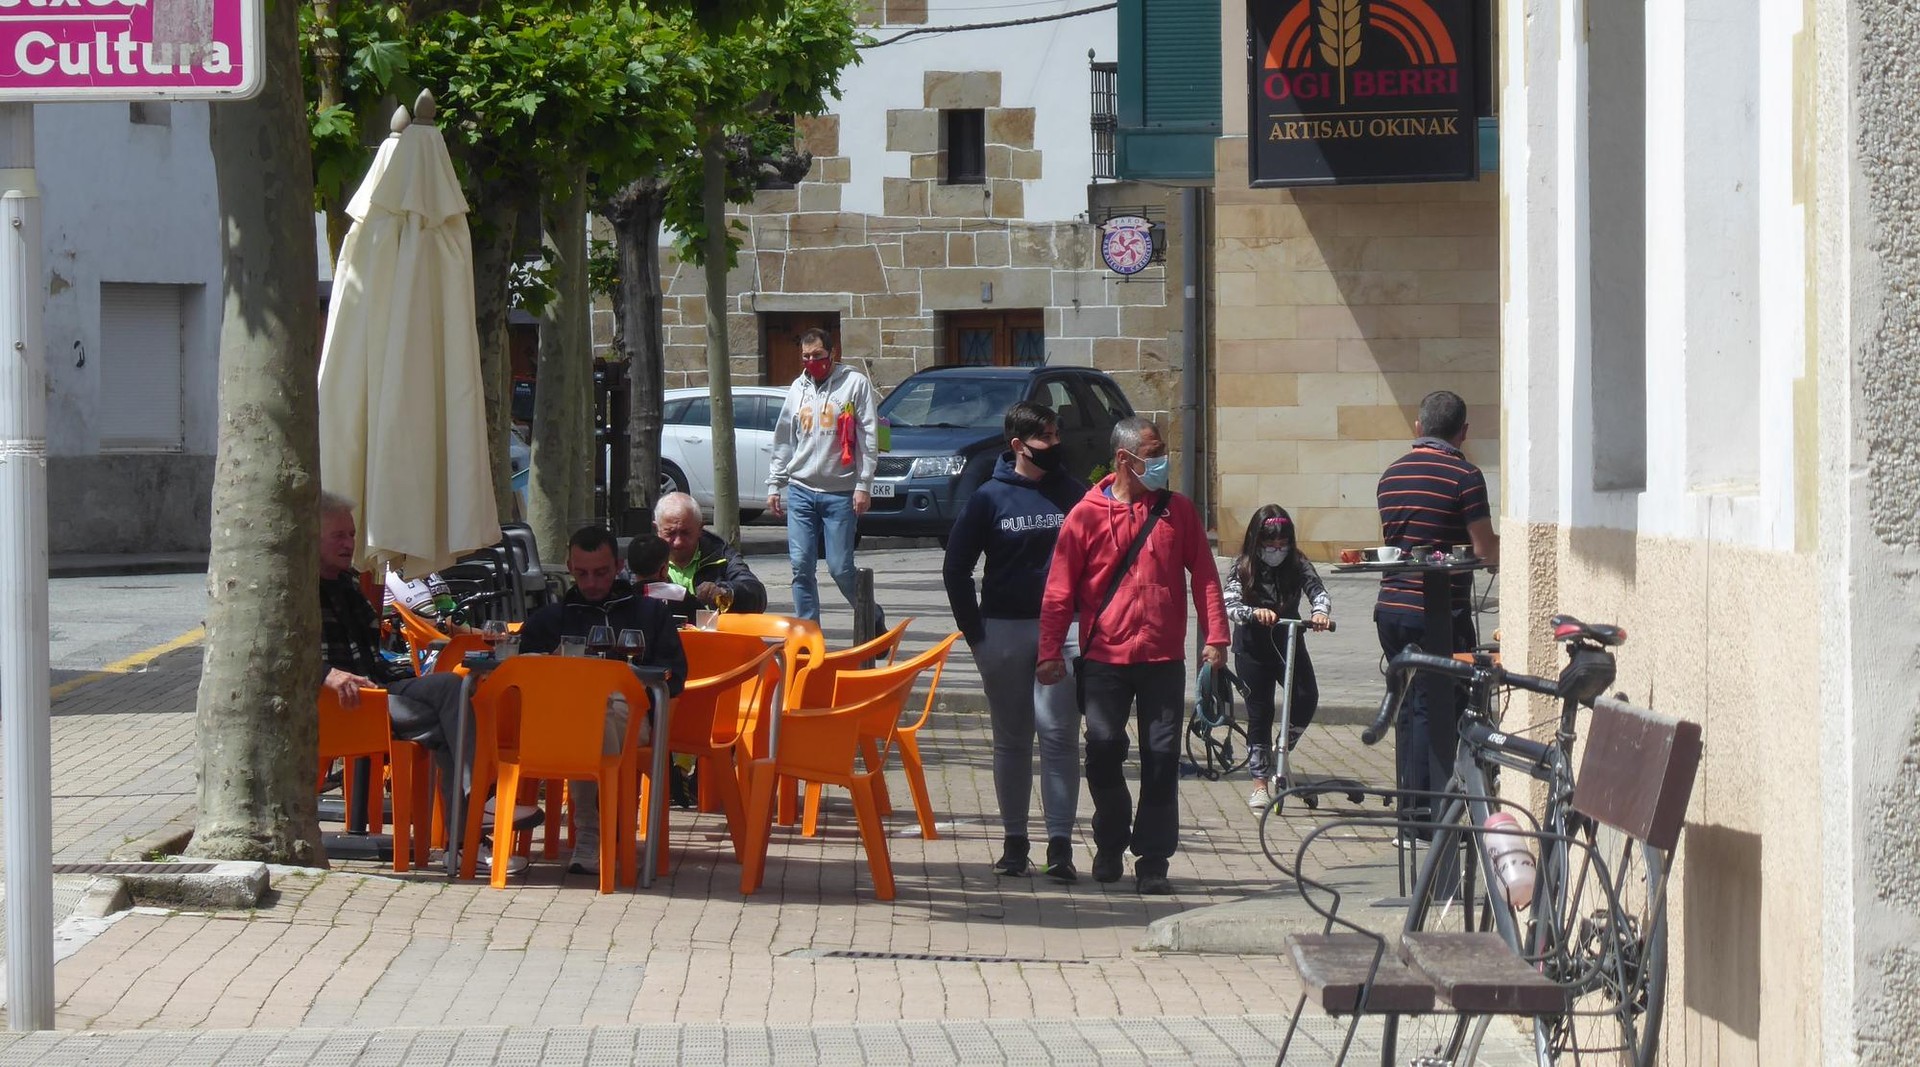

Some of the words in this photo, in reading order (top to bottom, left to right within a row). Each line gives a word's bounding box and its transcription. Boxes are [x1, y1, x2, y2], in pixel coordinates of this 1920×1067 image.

[15, 30, 233, 75] Cultura
[1263, 72, 1331, 101] OGI
[1352, 68, 1461, 98] BERRI
[1268, 120, 1364, 141] ARTISAU
[1369, 116, 1459, 137] OKINAK
[872, 484, 892, 496] GKR
[1001, 513, 1065, 532] PULL&BE
